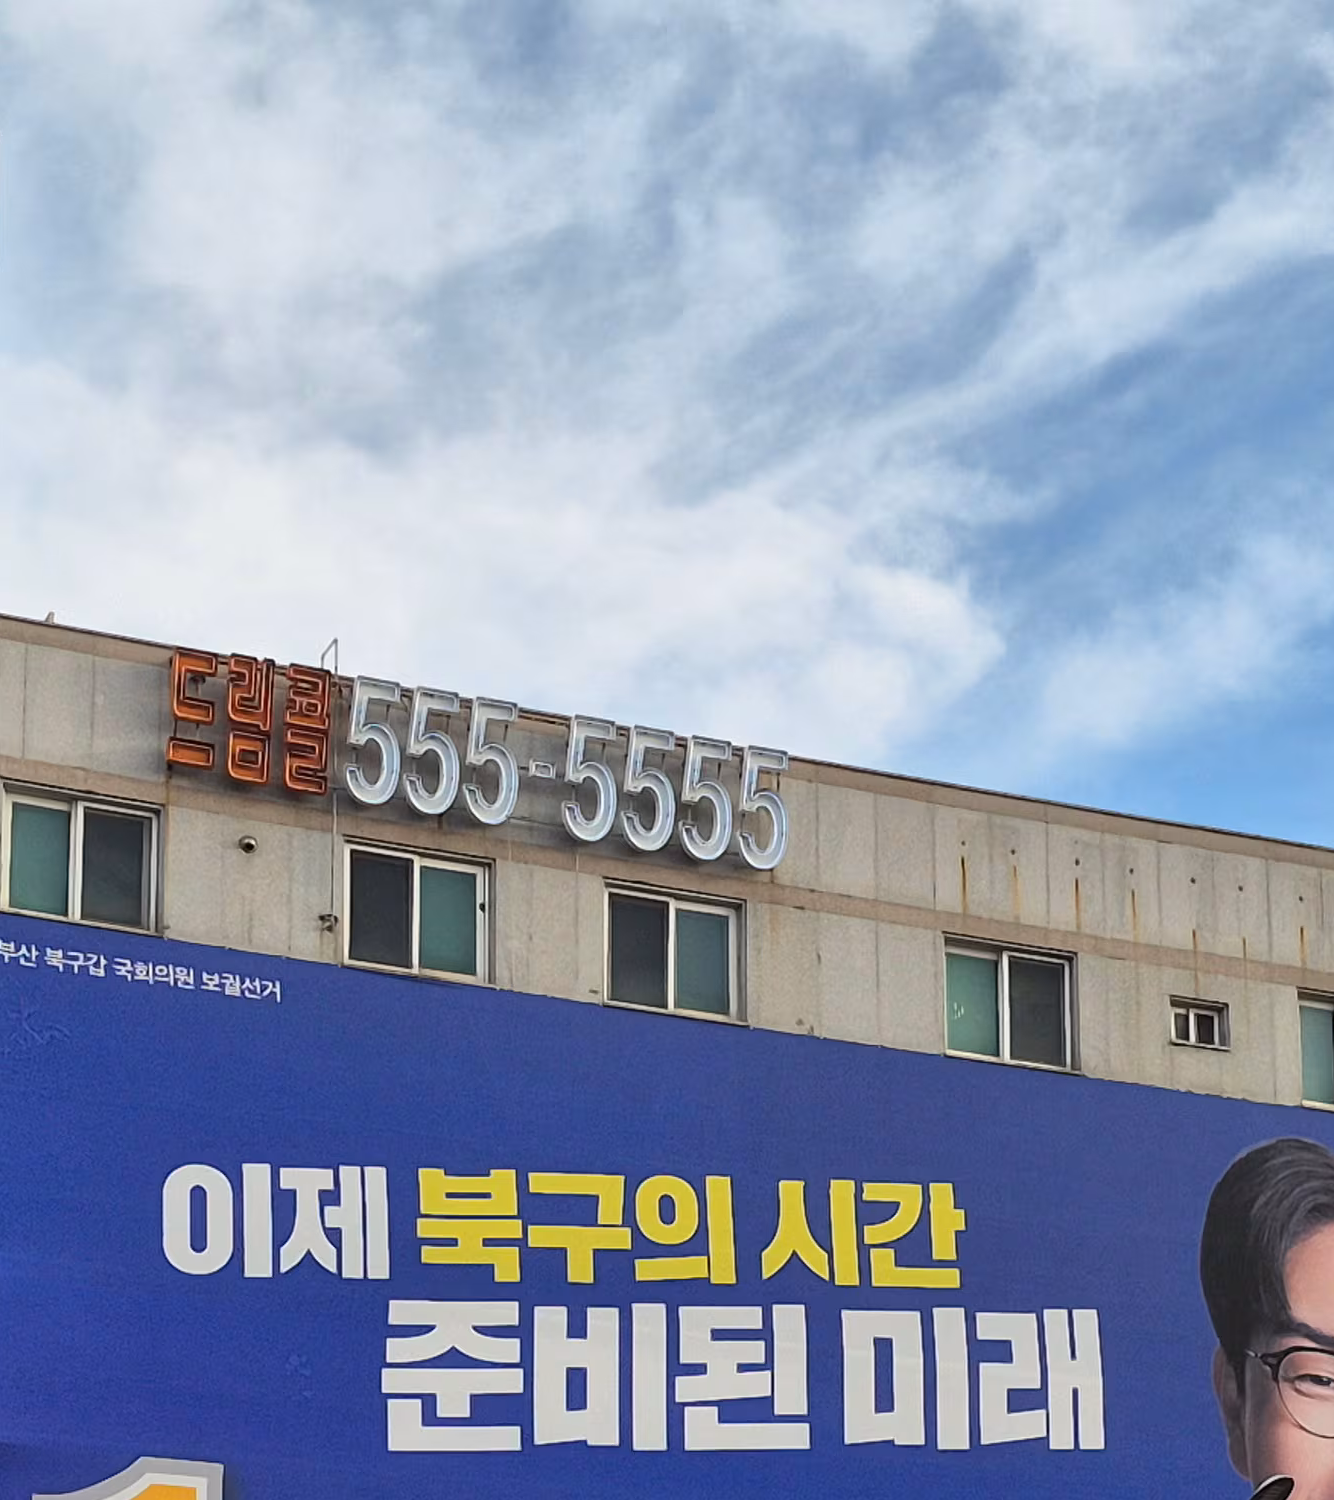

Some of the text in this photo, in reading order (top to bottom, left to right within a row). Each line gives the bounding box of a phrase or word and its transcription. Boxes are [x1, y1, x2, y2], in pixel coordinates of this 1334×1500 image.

[165, 648, 789, 871] 드림콜 555-5555
[43, 947, 108, 977] 북구갑
[112, 956, 195, 990] 국회의원
[200, 971, 283, 1003] 보궐선거
[161, 1162, 967, 1290] 이제 북구의 시간
[380, 1298, 1106, 1453] 준비된 미래
